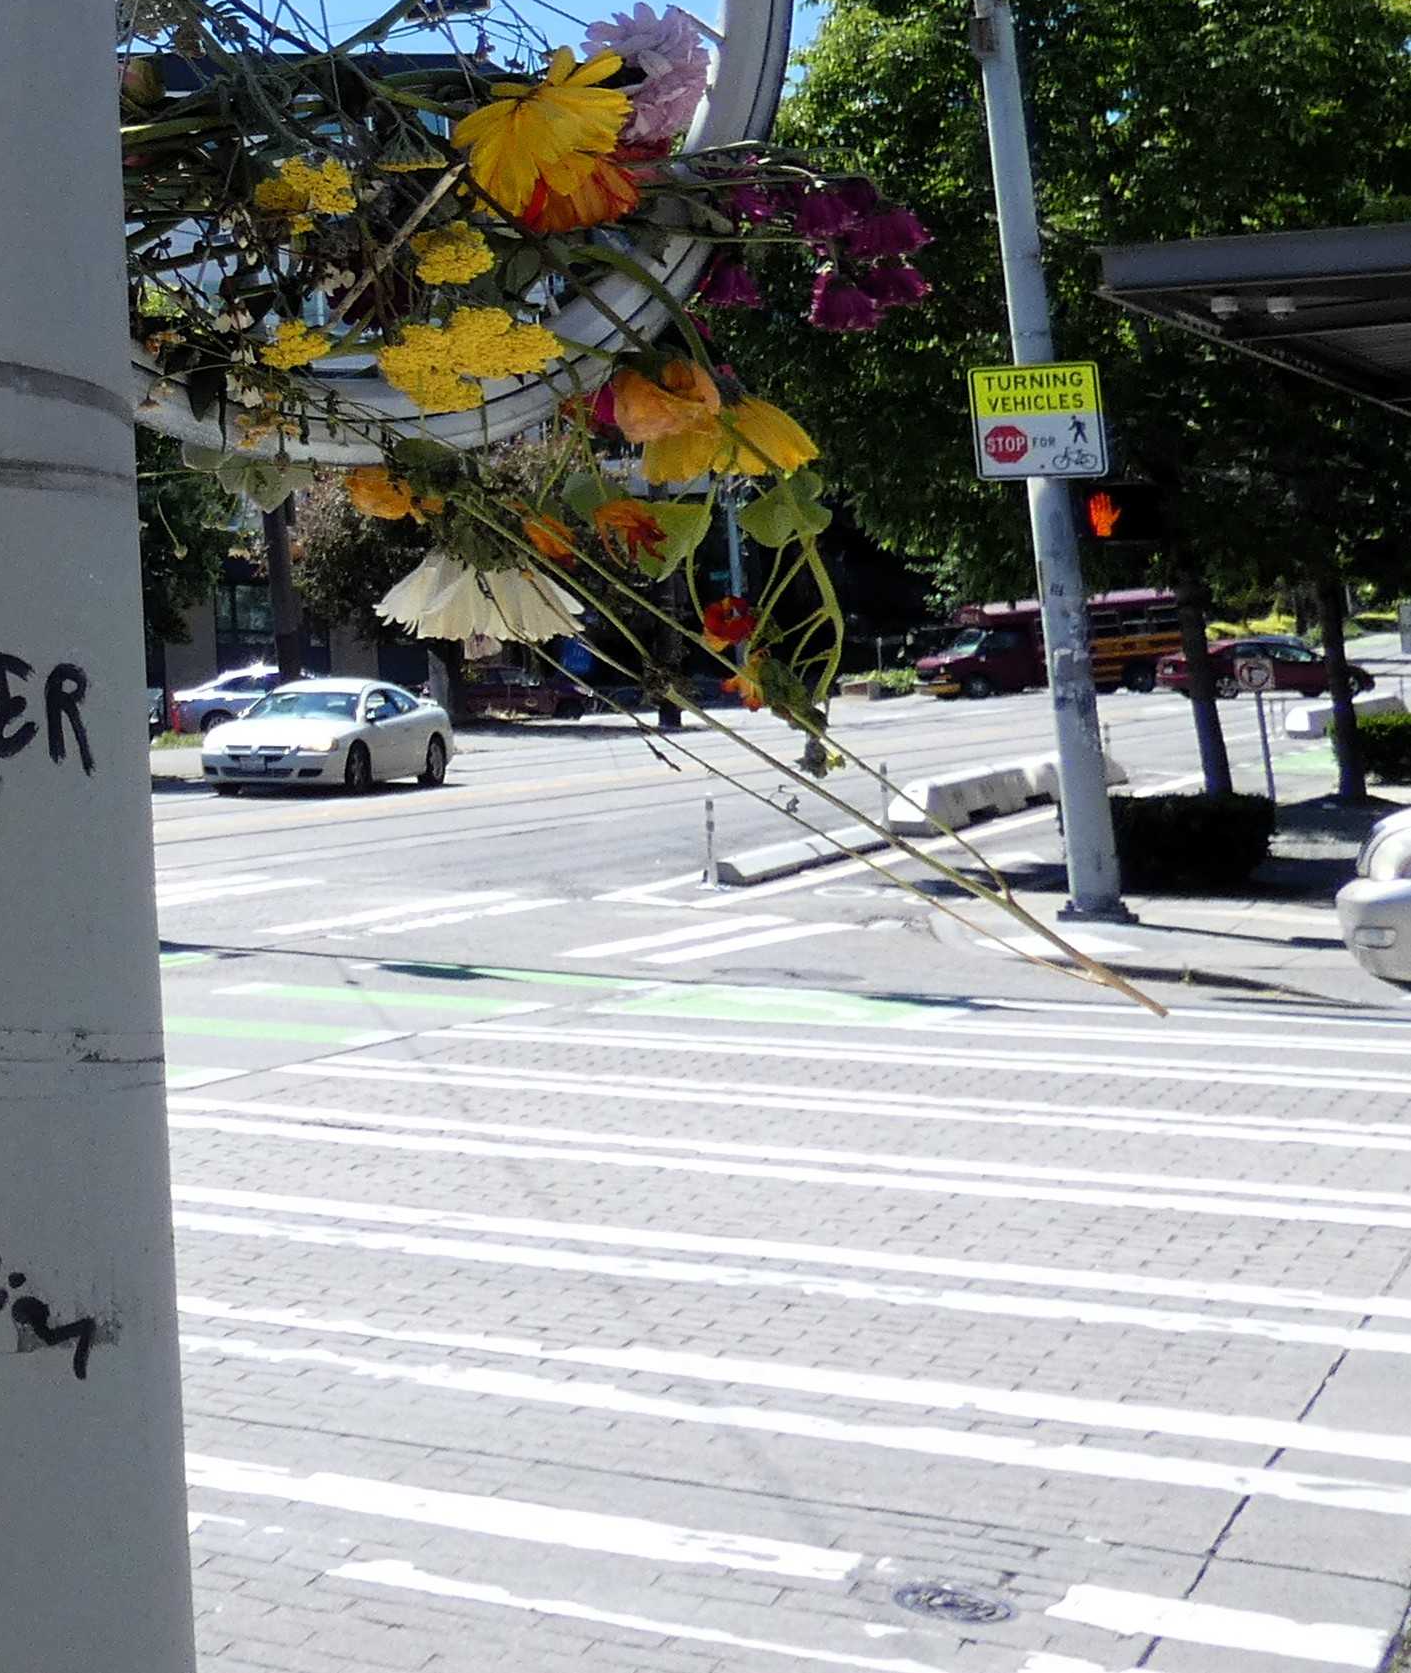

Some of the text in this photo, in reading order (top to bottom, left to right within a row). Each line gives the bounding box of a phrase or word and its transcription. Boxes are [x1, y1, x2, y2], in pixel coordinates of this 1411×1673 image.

[983, 371, 1083, 392] TURNING
[987, 393, 1084, 412] VEHICLES
[986, 436, 1056, 453] STOP FOR
